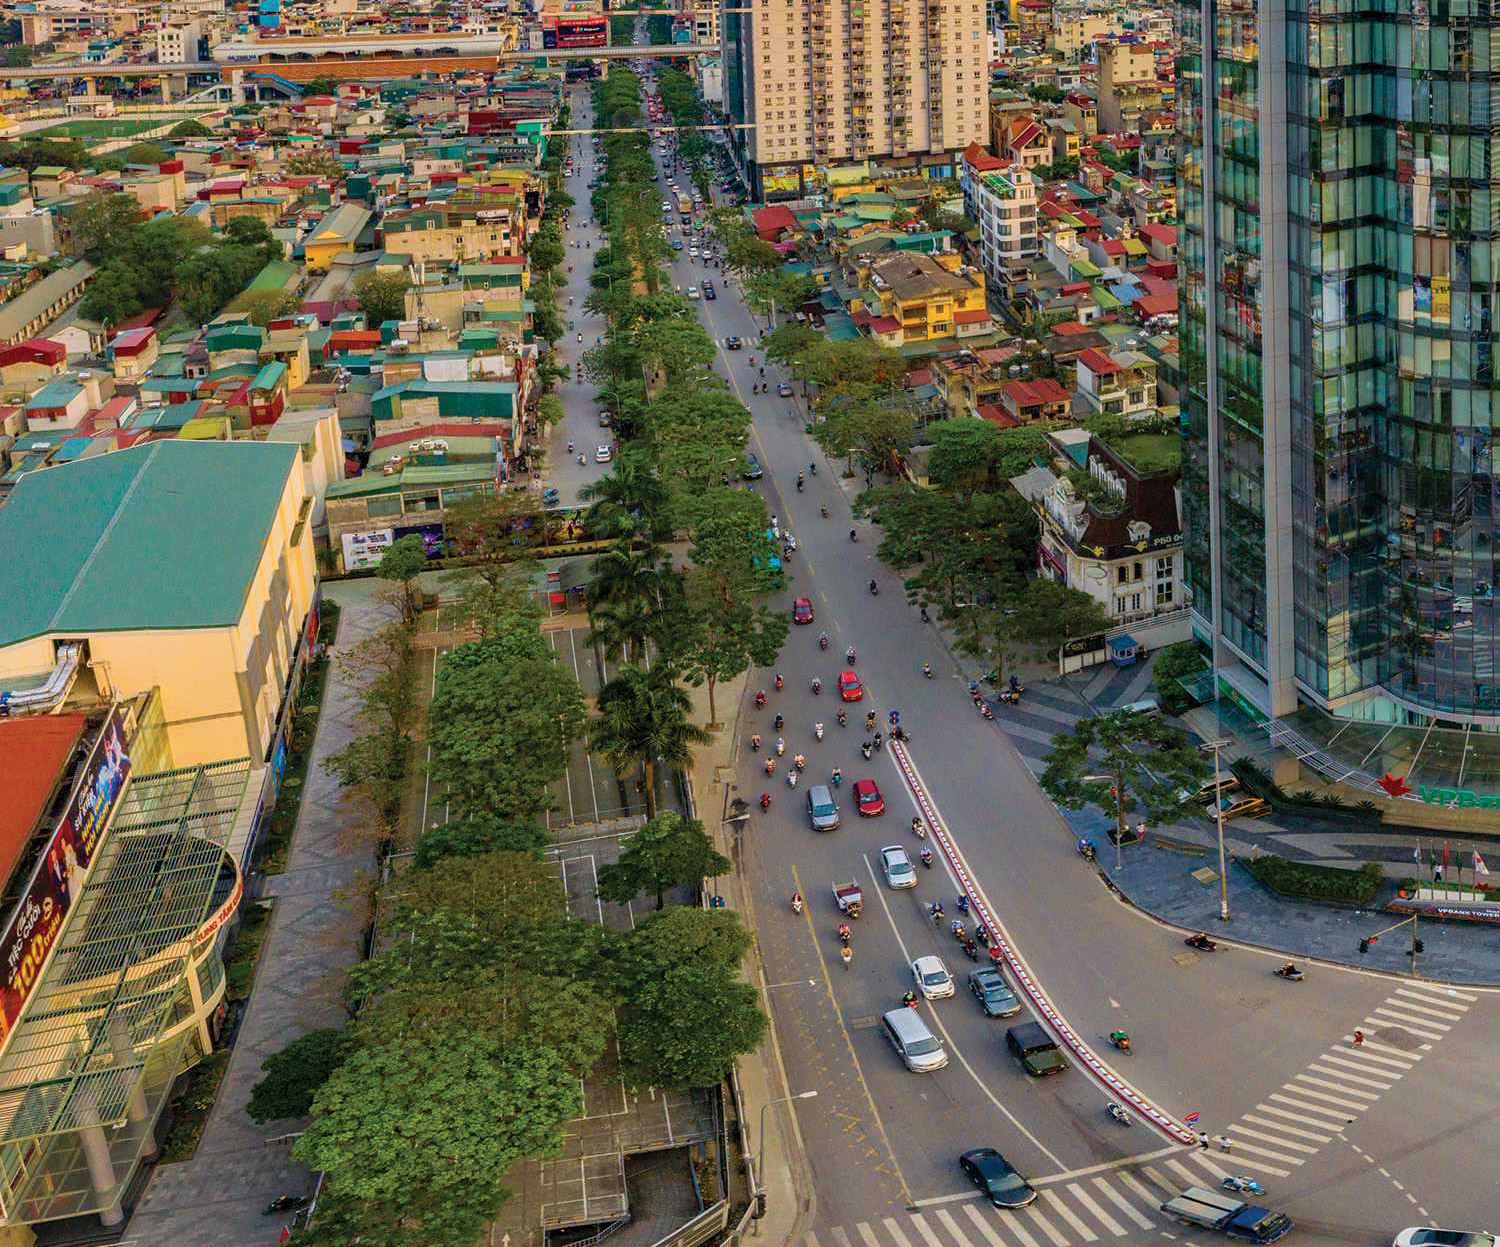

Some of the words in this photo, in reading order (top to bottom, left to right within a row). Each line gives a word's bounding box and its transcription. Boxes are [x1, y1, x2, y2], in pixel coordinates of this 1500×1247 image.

[218, 902, 234, 923] TÂM
[1438, 908, 1470, 917] VPBANK
[8, 939, 23, 968] TIỆC
[23, 903, 41, 939] CƯỚI
[14, 934, 44, 999] 100
[44, 912, 60, 947] triệu
